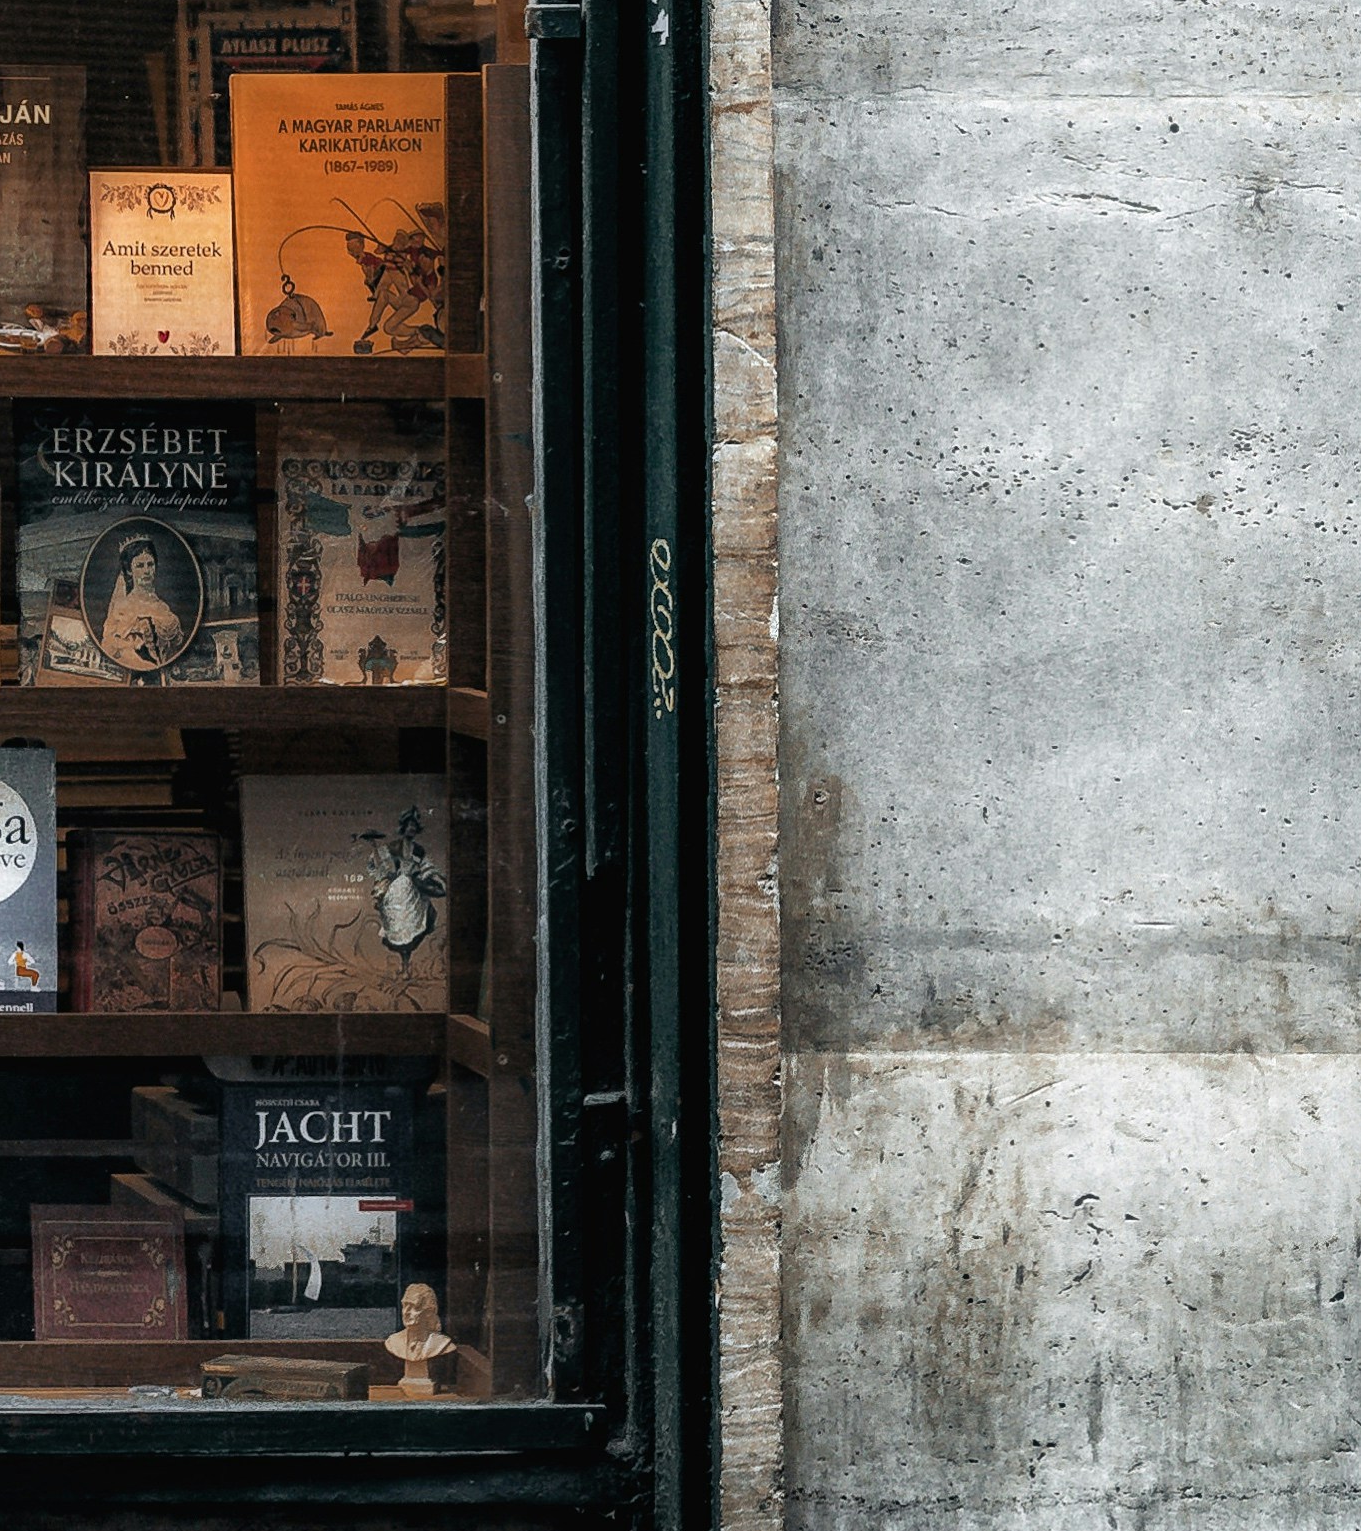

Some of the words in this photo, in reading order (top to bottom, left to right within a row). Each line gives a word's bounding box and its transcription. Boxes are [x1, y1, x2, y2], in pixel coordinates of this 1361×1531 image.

[278, 119, 288, 133] A
[292, 119, 353, 133] MAGYAR
[358, 118, 442, 133] PARLAMENT
[299, 135, 422, 153] KARIKATÚRÁKON
[102, 240, 146, 257] Amit
[151, 241, 222, 257] szeretek
[130, 260, 193, 276] benned
[53, 422, 228, 455] ERZSÉBET
[53, 456, 228, 489] KIRÁLYNÉ
[131, 489, 229, 512] képeslapokon
[254, 1111, 392, 1150] JACHT
[255, 1150, 363, 1168] NAVIGÁTOR
[367, 1152, 391, 1168] III.
